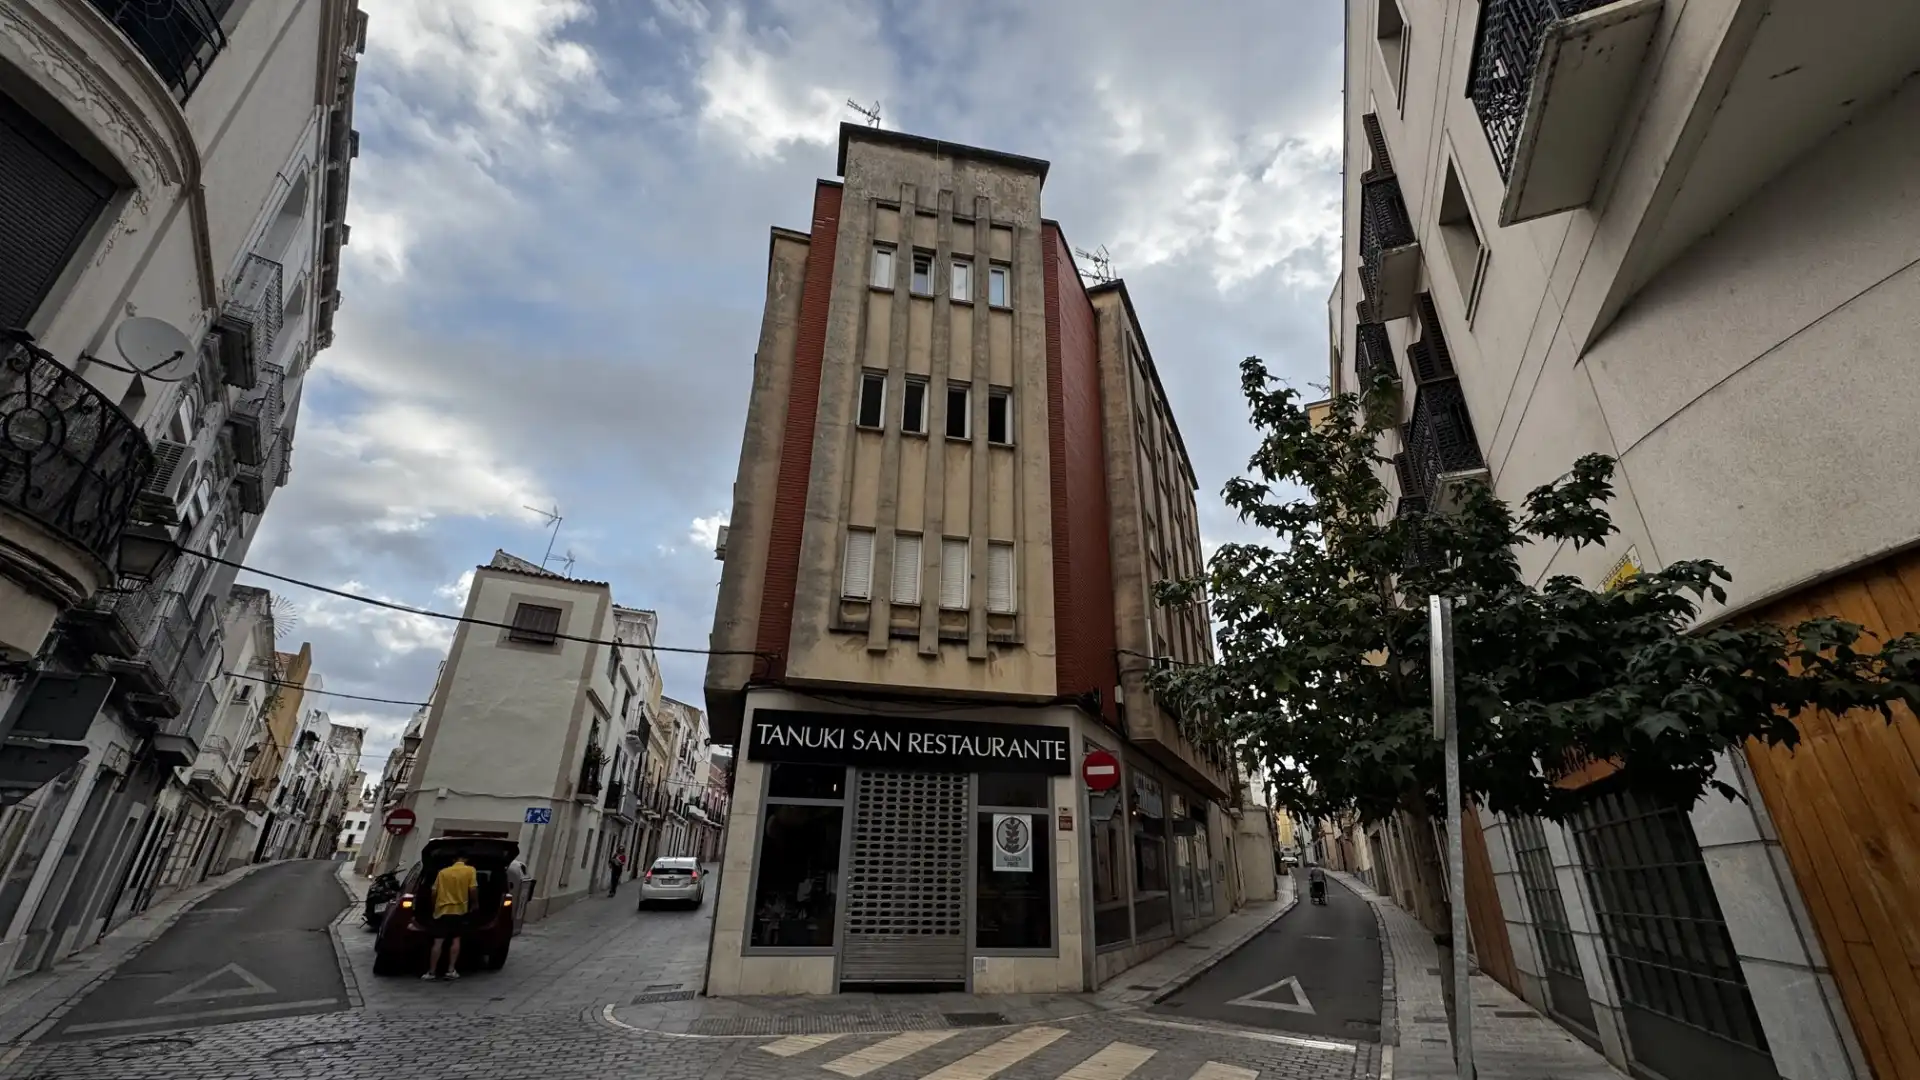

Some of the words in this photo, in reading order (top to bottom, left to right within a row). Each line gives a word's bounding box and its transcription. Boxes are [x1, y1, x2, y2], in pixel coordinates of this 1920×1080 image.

[757, 723, 845, 749] TANUKI
[852, 729, 901, 752] SAN
[908, 732, 1066, 761] RESTAURANTE
